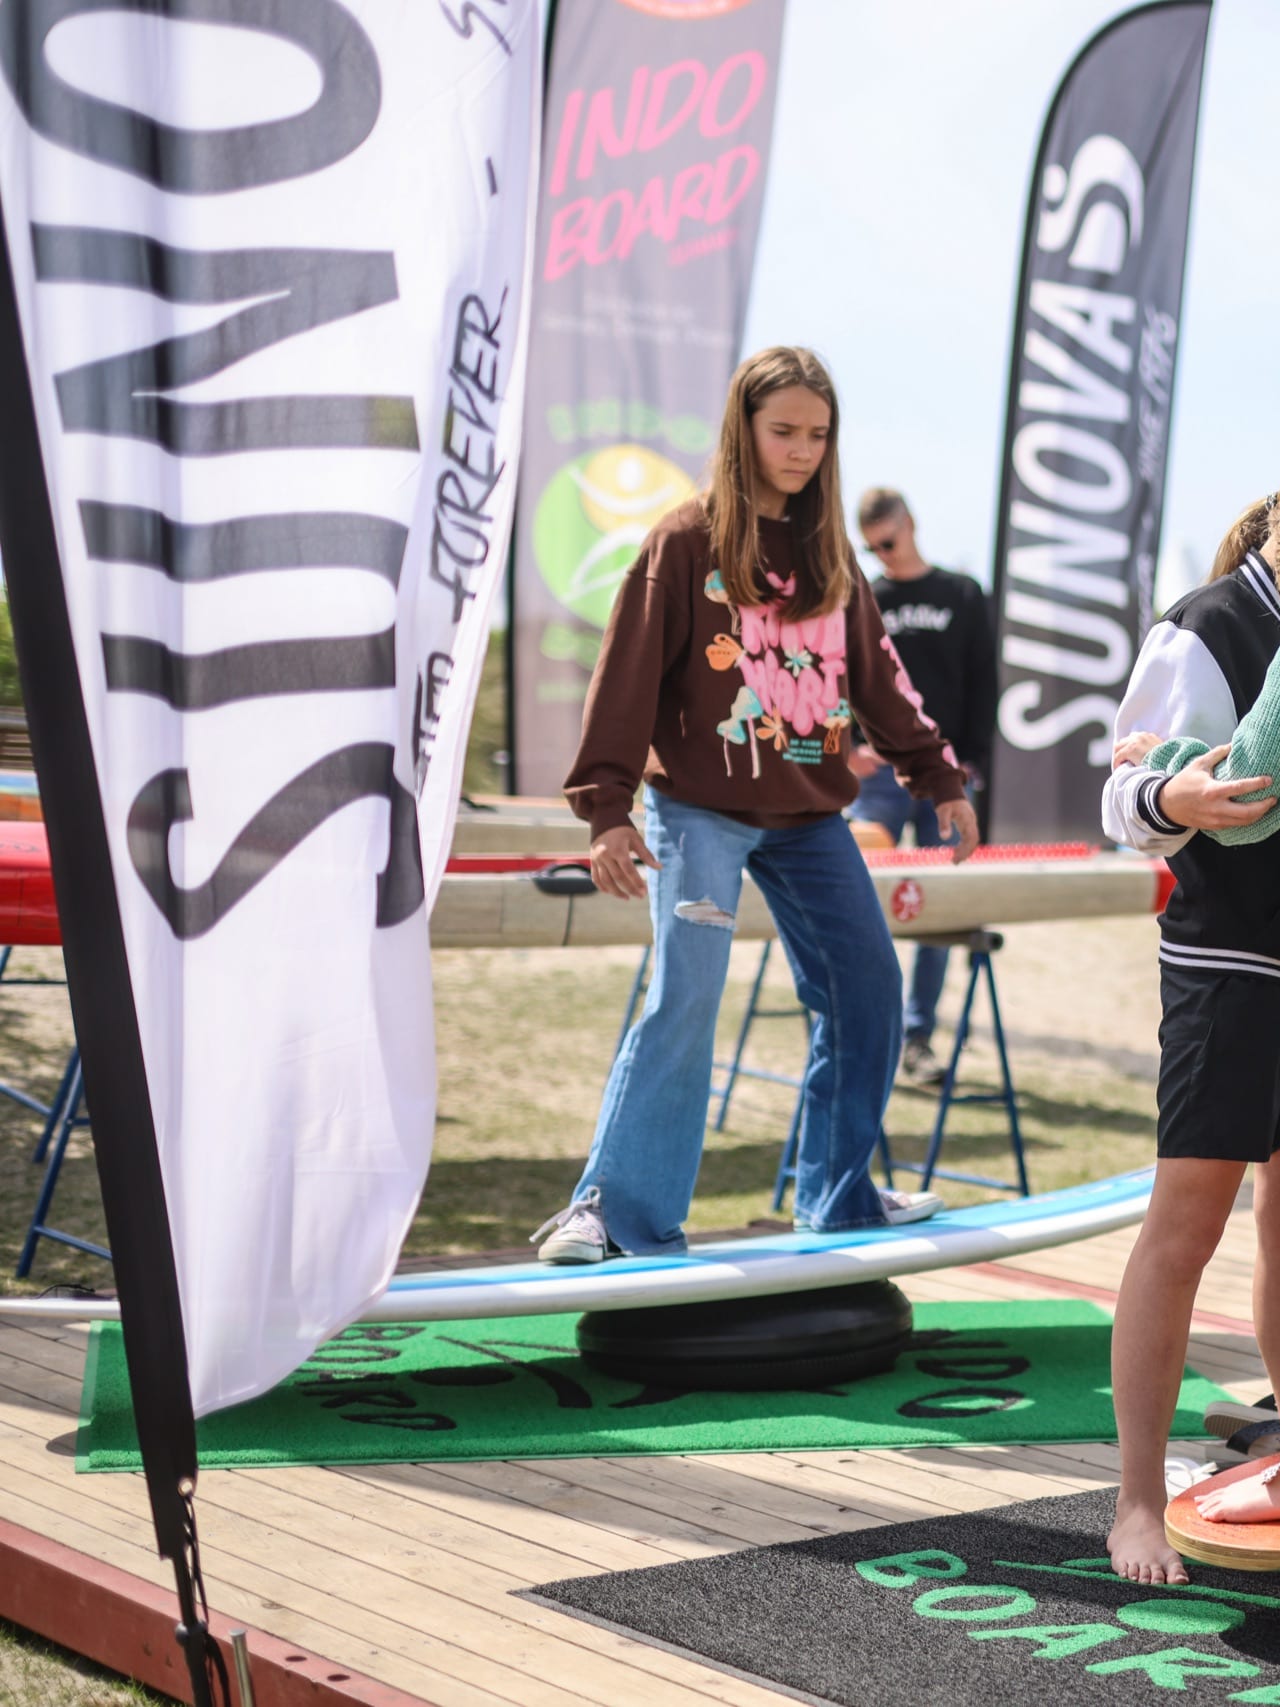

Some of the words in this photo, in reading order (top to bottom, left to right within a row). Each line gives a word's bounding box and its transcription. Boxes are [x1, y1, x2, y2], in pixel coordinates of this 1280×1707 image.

[549, 50, 768, 197] INDO
[544, 145, 761, 282] BOARD
[427, 285, 509, 624] FOREVER
